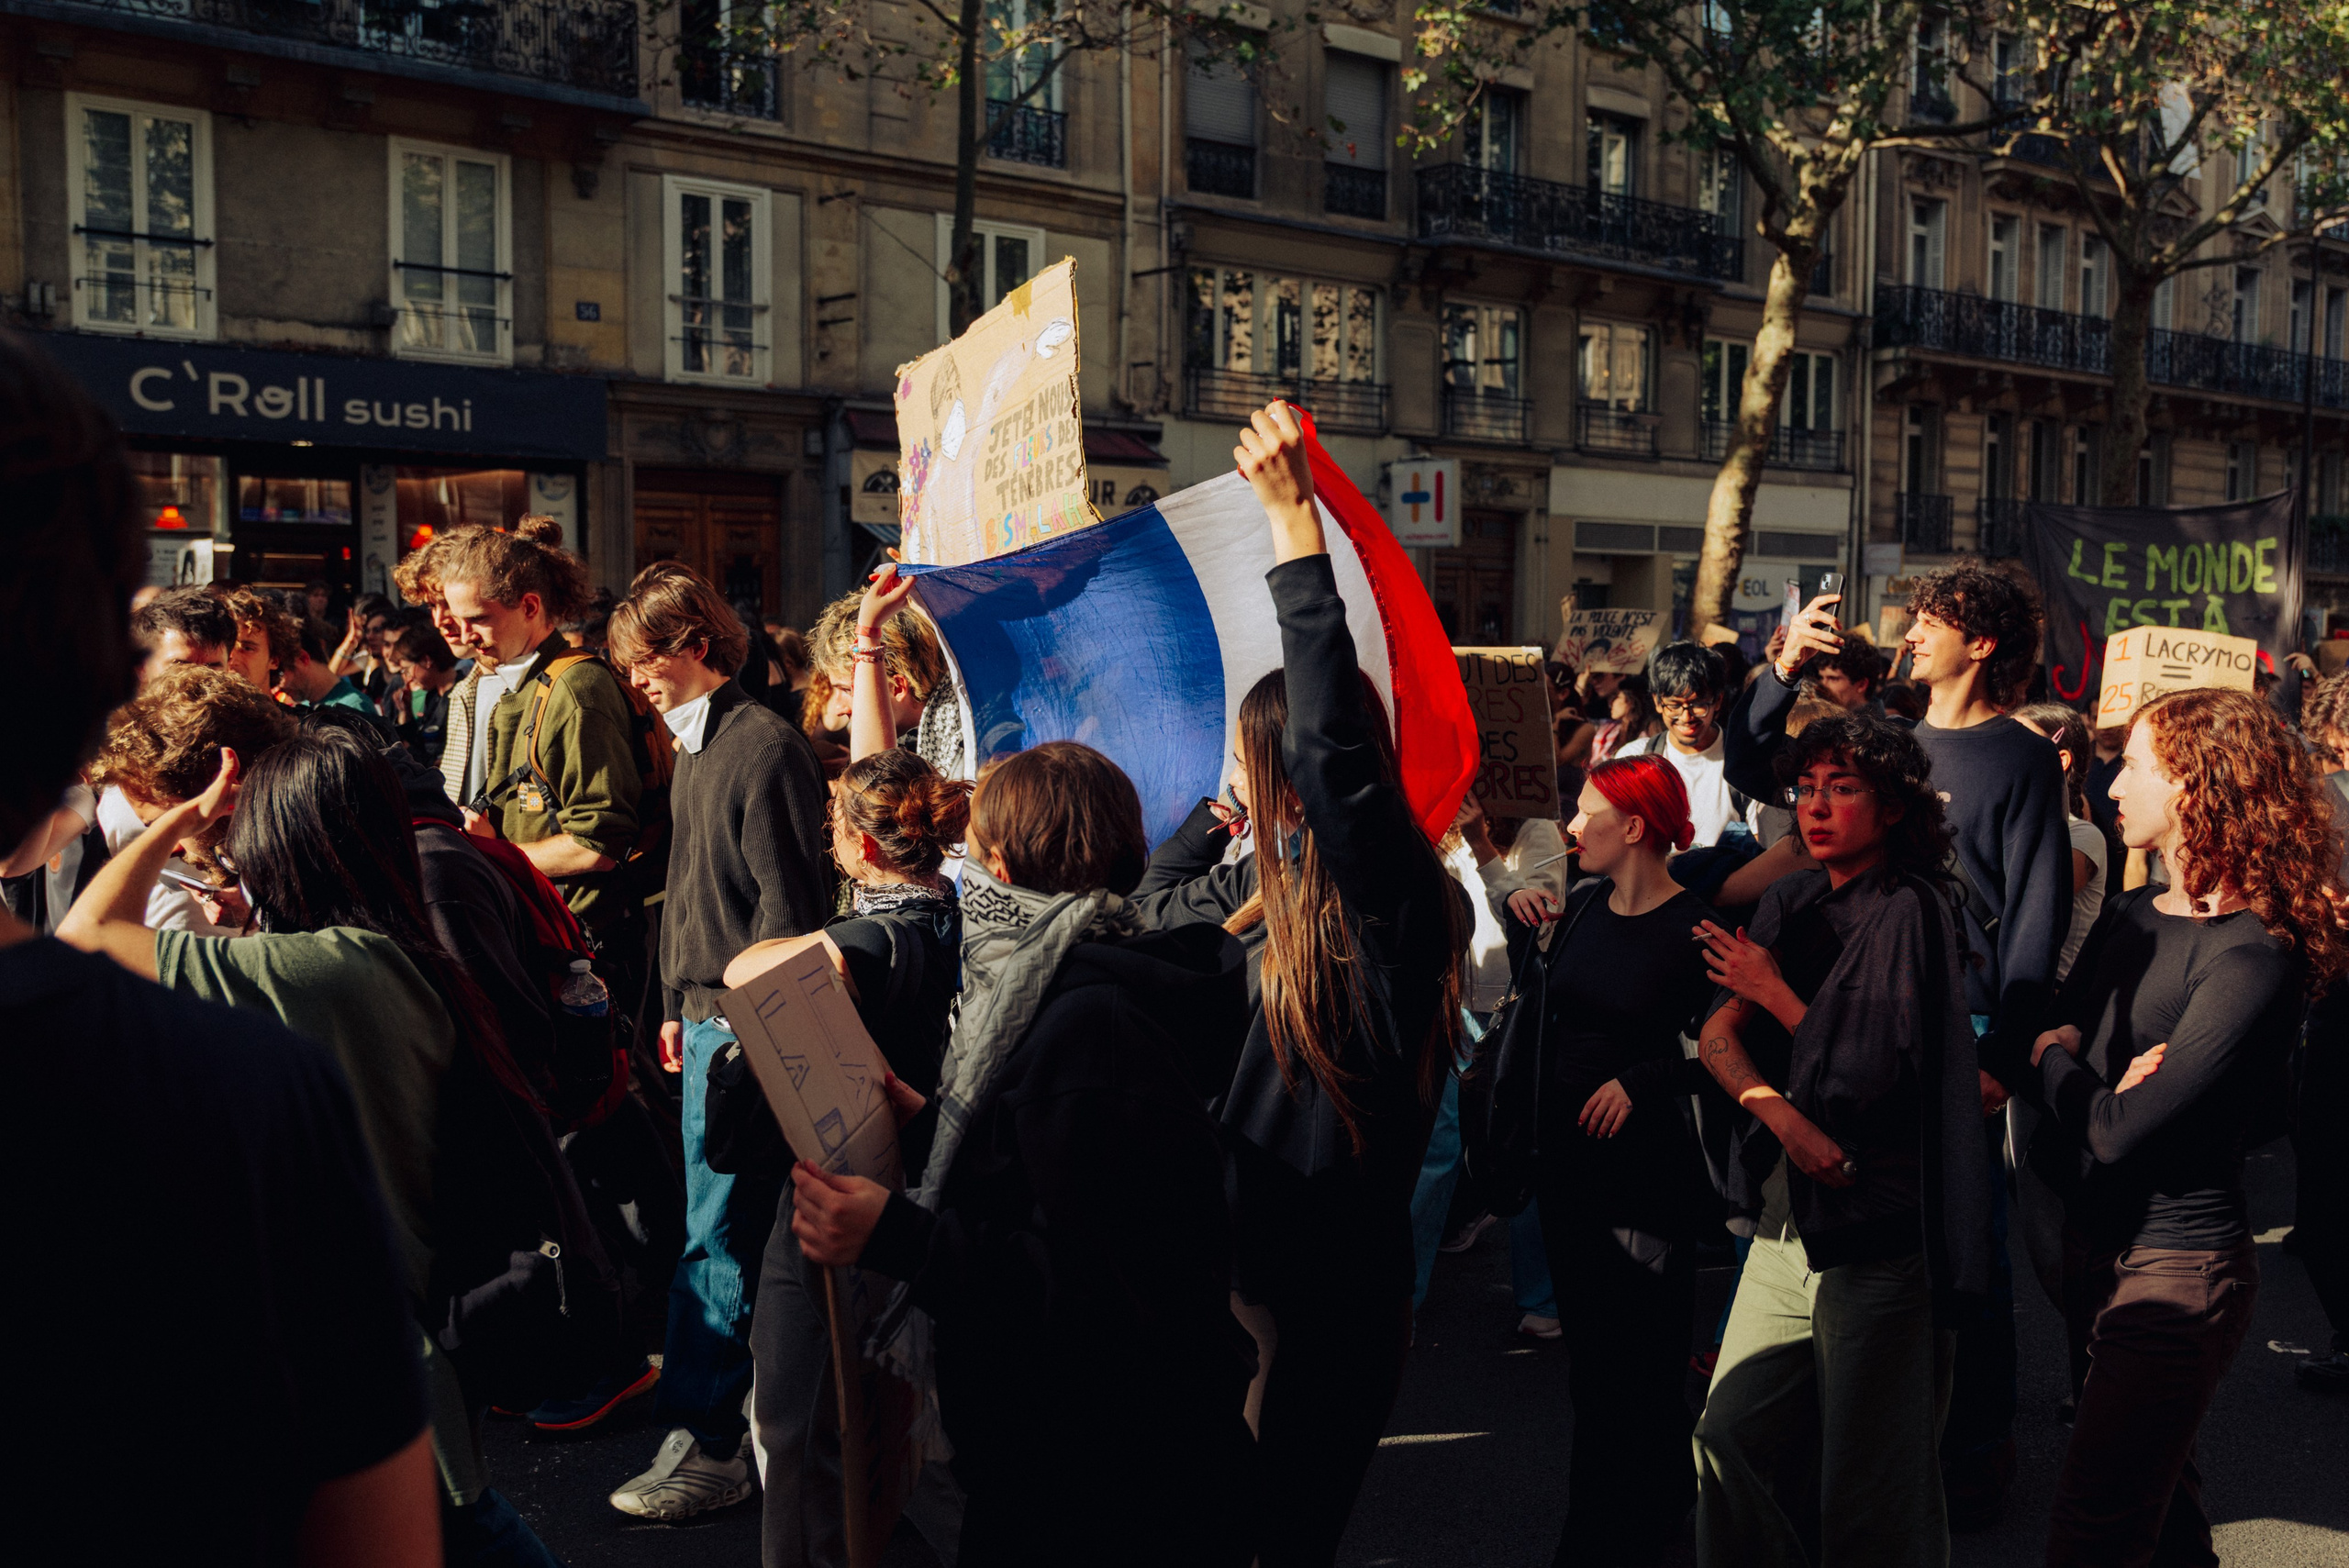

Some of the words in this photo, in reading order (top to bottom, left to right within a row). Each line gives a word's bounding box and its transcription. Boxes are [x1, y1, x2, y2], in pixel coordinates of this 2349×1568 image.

[344, 396, 473, 432] sushi
[1038, 380, 1073, 425] NOUS
[985, 450, 1008, 484] DES
[1013, 422, 1053, 470] FLEURS
[1058, 417, 1078, 449] DES
[2067, 538, 2130, 591] LE
[2144, 536, 2278, 595] MONDE
[1570, 611, 1583, 624] LA
[1620, 610, 1657, 626] N'EST
[2103, 597, 2192, 638] EST
[1493, 653, 1539, 685] DES
[2113, 635, 2132, 662] 1
[2144, 632, 2253, 673] LACRYMO
[2100, 681, 2134, 715] 25
